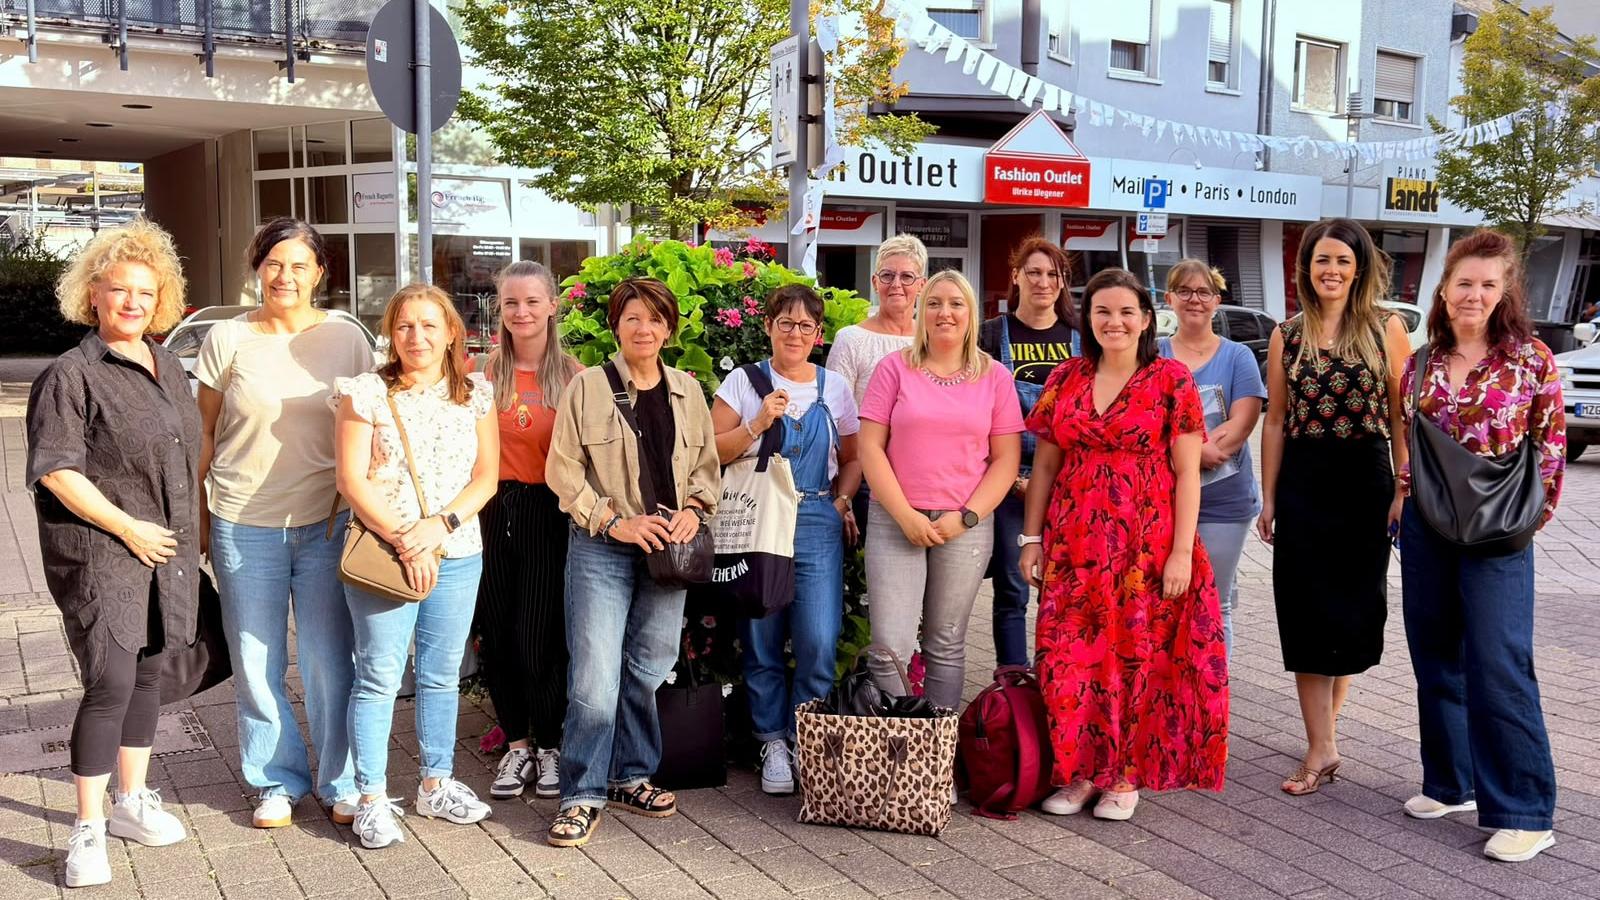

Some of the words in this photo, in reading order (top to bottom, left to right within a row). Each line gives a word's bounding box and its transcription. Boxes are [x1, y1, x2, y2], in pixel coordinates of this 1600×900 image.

[859, 152, 957, 188] Outlet
[994, 166, 1040, 182] Fashion
[1044, 169, 1082, 185] Outlet
[1397, 166, 1427, 180] PIANO
[1034, 189, 1064, 199] Wegener
[1112, 175, 1173, 197] Maild
[1195, 181, 1230, 201] Paris
[1250, 186, 1297, 205] London
[1148, 182, 1162, 205] P
[1385, 177, 1440, 213] Landt
[1009, 342, 1072, 360] NIRVAN
[712, 558, 749, 582] EHERIN
